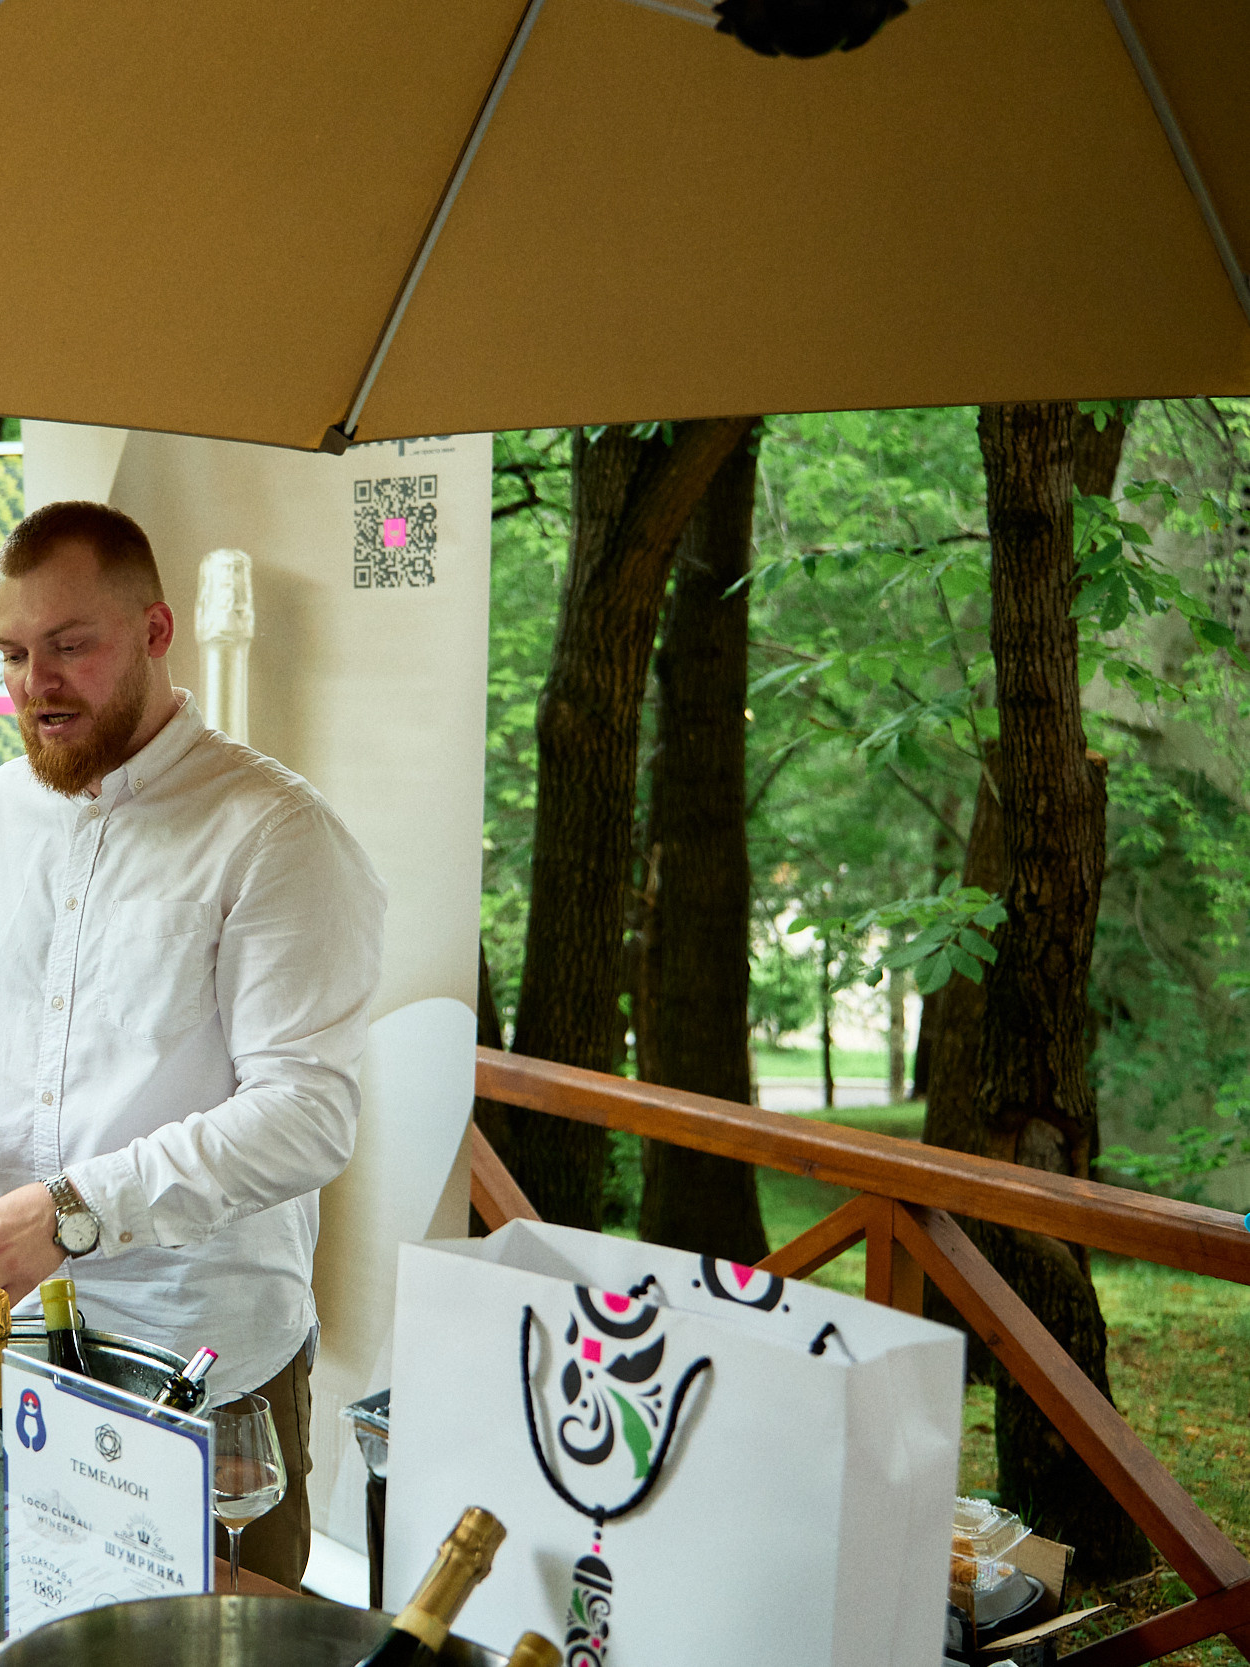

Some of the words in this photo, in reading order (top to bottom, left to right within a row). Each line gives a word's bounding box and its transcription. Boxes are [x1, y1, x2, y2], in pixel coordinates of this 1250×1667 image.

[70, 1457, 149, 1501] ТЕМЕЛИОН
[22, 1494, 48, 1512] LOCO
[51, 1507, 92, 1532] CIMBALI
[105, 1541, 185, 1587] ШУМРИНКА
